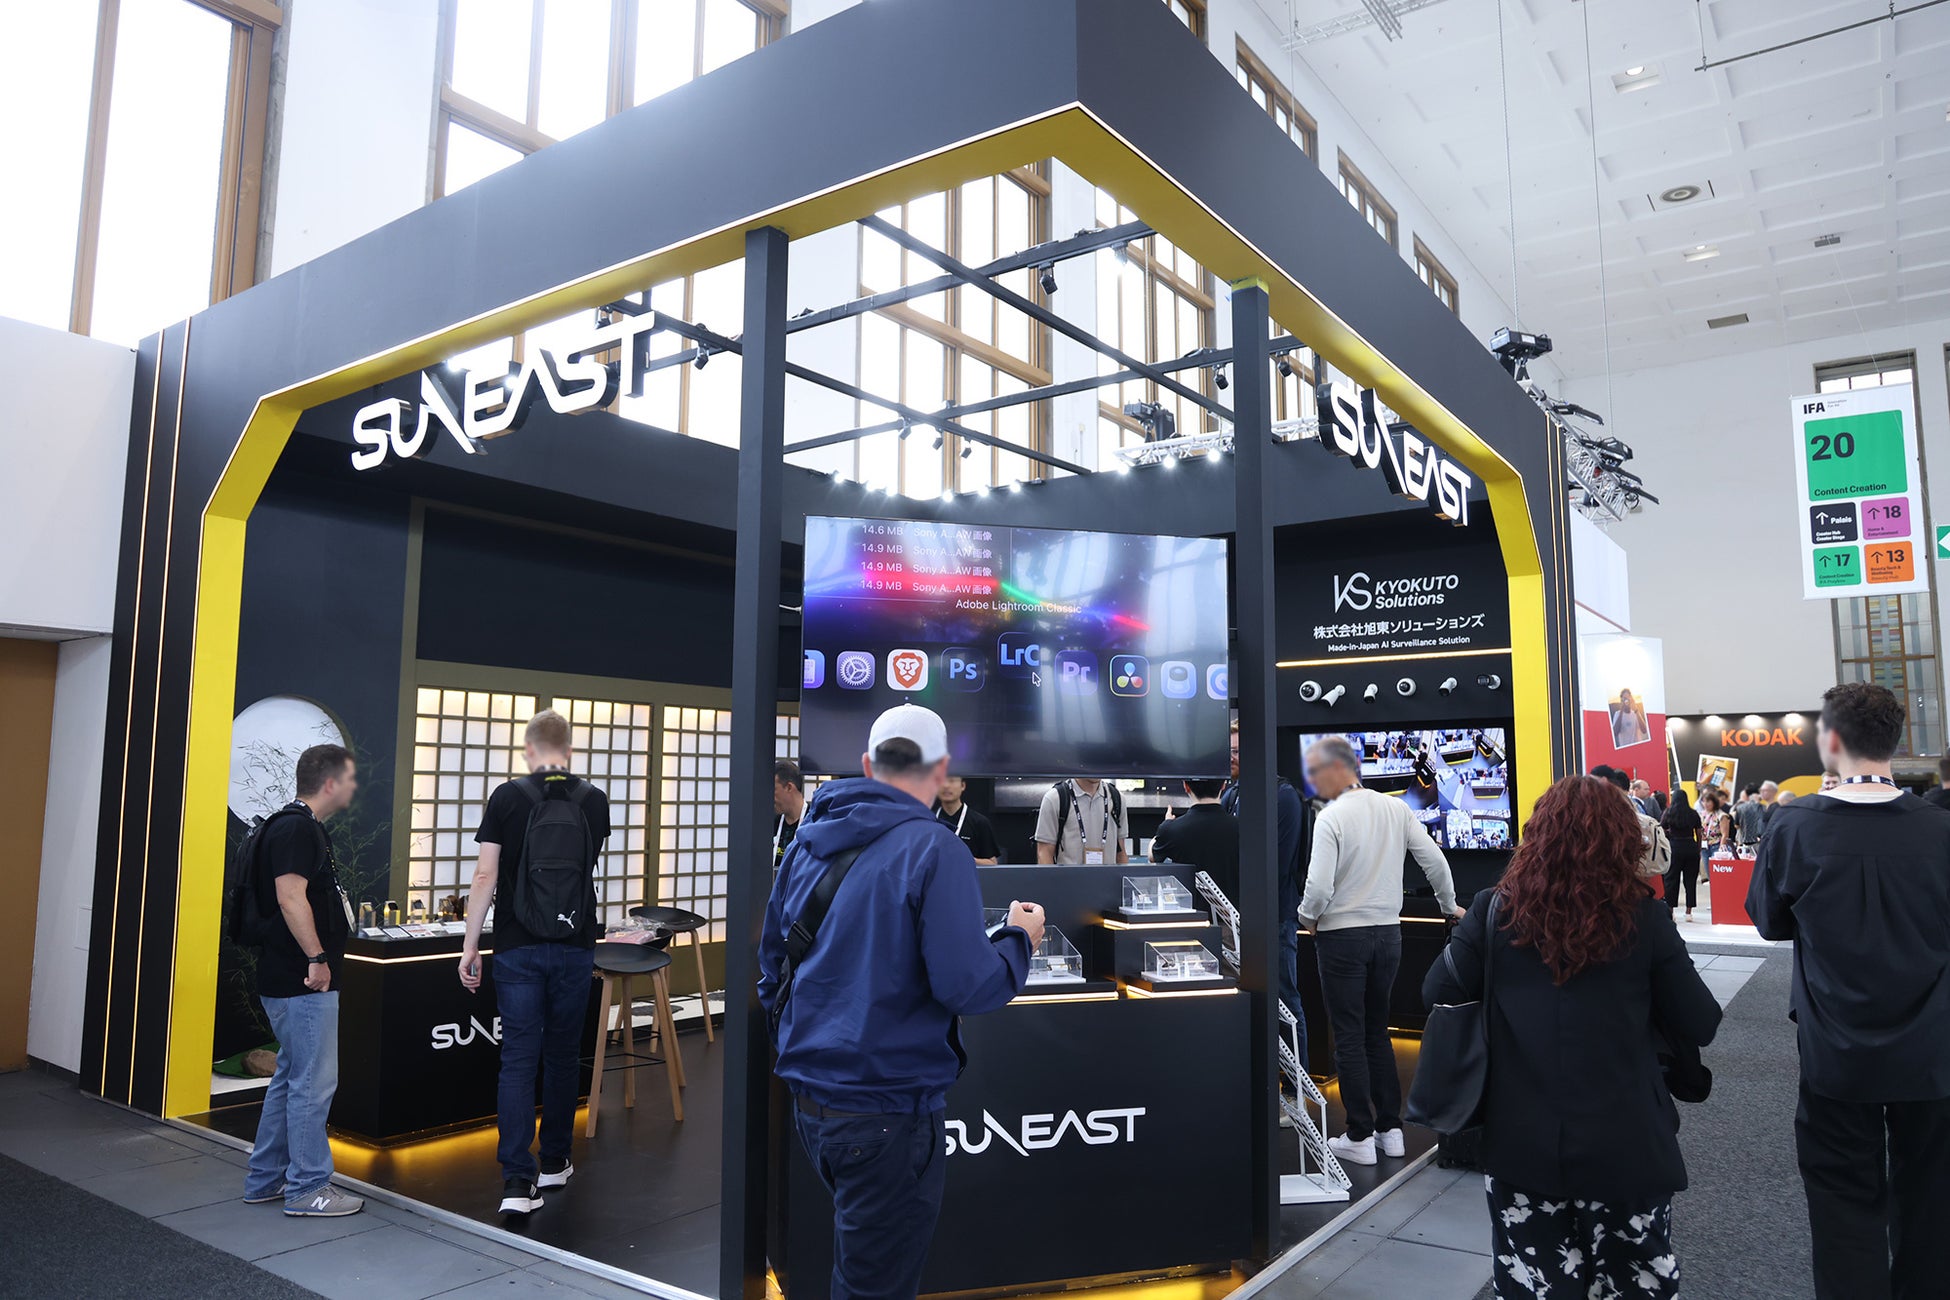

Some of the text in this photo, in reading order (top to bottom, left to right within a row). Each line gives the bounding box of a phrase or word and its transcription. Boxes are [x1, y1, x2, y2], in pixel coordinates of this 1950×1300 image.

[351, 310, 655, 471] SUNEAST
[1803, 402, 1825, 414] IFA
[1330, 380, 1472, 526] SUNEAST
[1811, 432, 1854, 461] 20
[1814, 483, 1887, 496] Content Creation
[1883, 505, 1901, 519] 18
[1830, 516, 1852, 524] Palais
[862, 525, 884, 535] 14.6
[887, 526, 904, 536] MB
[914, 527, 937, 539] Sony
[862, 543, 884, 553] 14.9
[886, 545, 903, 554] MB
[913, 546, 937, 557] Sony
[1886, 549, 1905, 563] 13
[1834, 553, 1851, 567] 17
[861, 561, 883, 571] 14.9
[886, 563, 902, 572] MB
[912, 563, 938, 575] Sony
[860, 580, 883, 590] 14.9
[885, 581, 902, 590] MB
[912, 582, 937, 593] Sony
[1375, 574, 1459, 595] KYOKUTO
[955, 599, 1082, 614] Adobe Lightroom Classic
[1375, 592, 1445, 609] Solutions
[1313, 613, 1485, 640] 株式会社旭東ソリューションズ
[1381, 641, 1389, 649] AI
[1391, 638, 1437, 648] Surveillance
[1438, 635, 1470, 645] Solution
[1001, 643, 1040, 666] LrC
[950, 658, 977, 680] Ps
[1063, 661, 1090, 683] Pr
[1721, 727, 1804, 747] KODAK
[1712, 863, 1733, 873] New
[431, 1014, 503, 1050] SUNE
